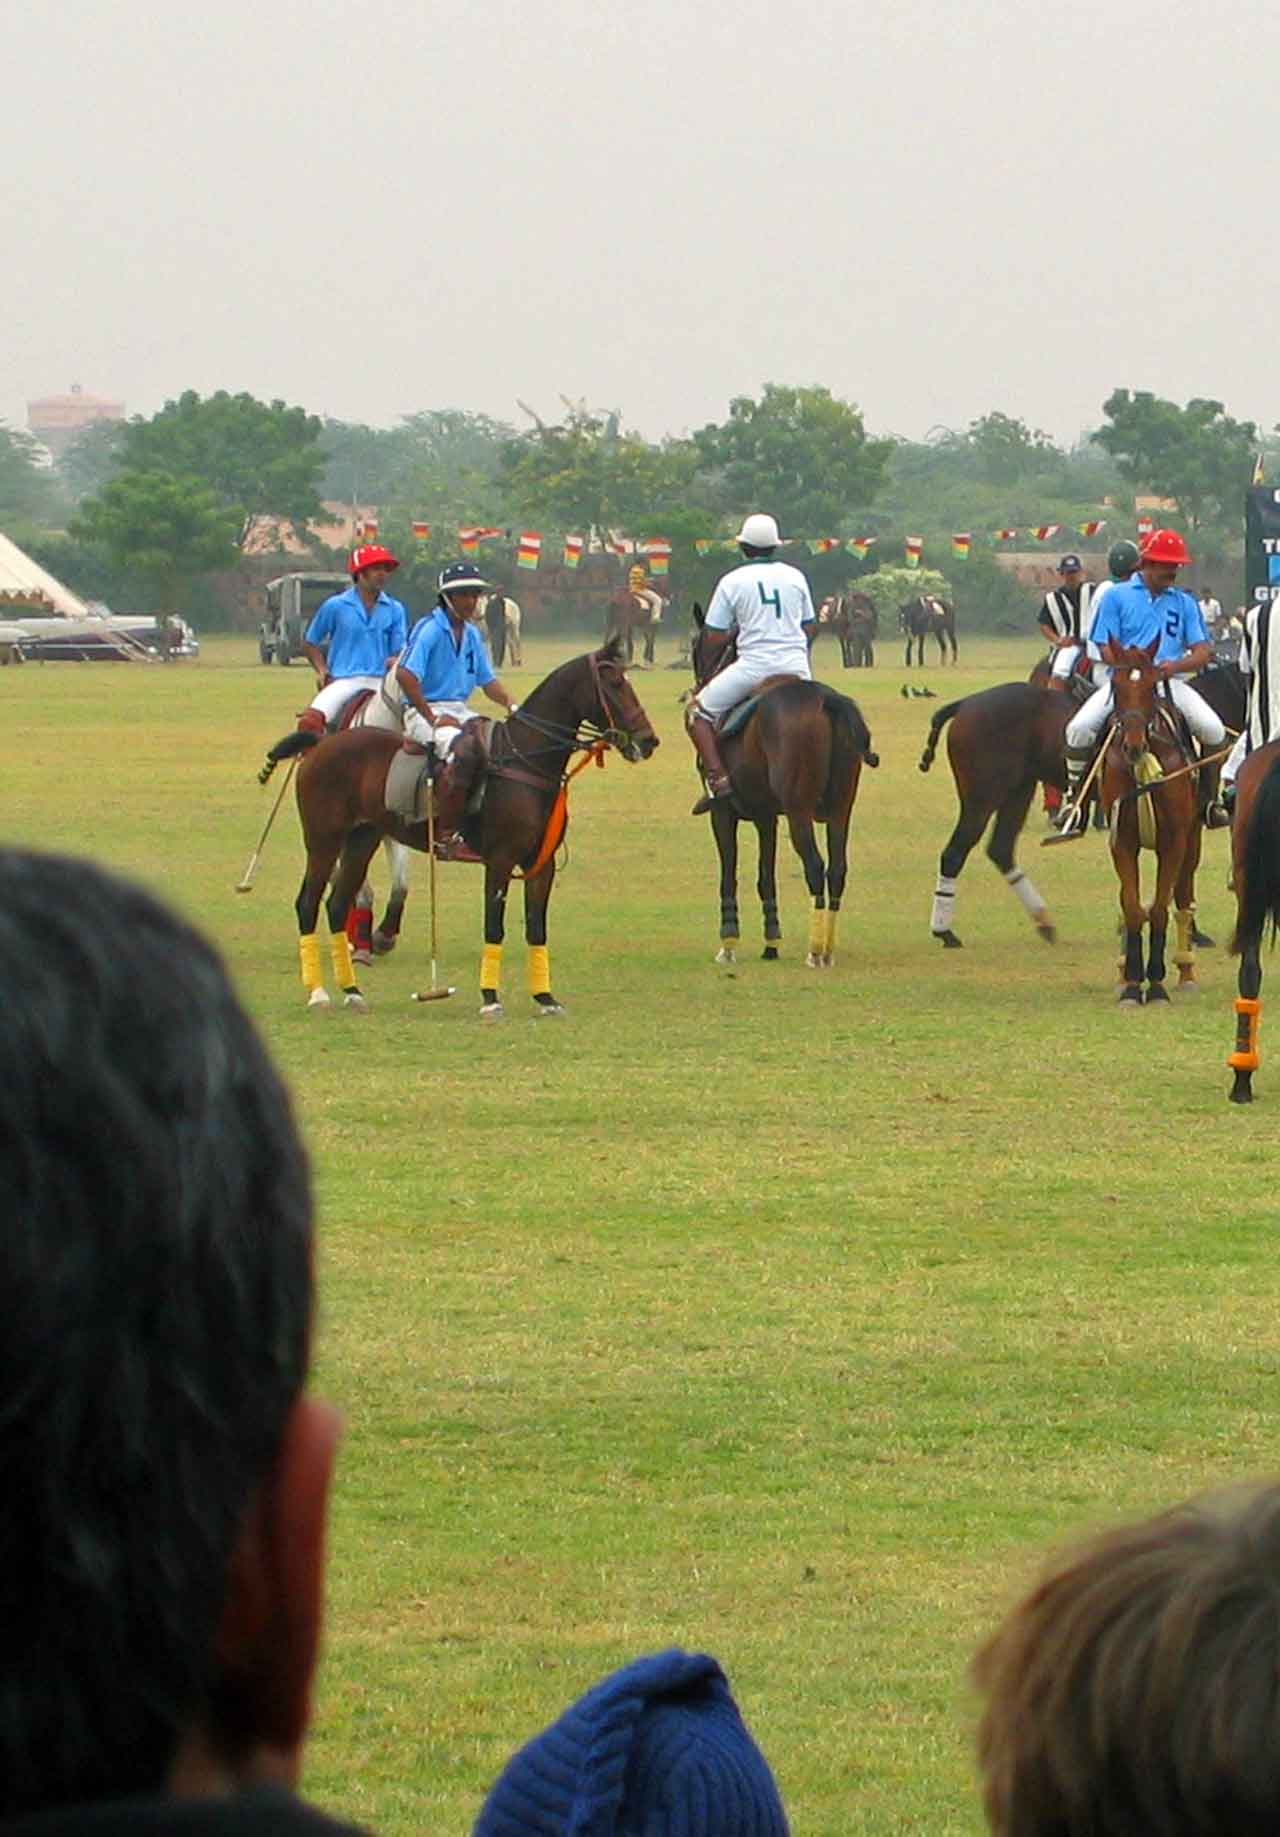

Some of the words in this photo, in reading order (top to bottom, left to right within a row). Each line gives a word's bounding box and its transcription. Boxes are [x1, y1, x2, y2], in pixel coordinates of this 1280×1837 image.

[758, 581, 781, 619] 4
[1166, 610, 1180, 637] 2
[465, 650, 475, 674] 1
